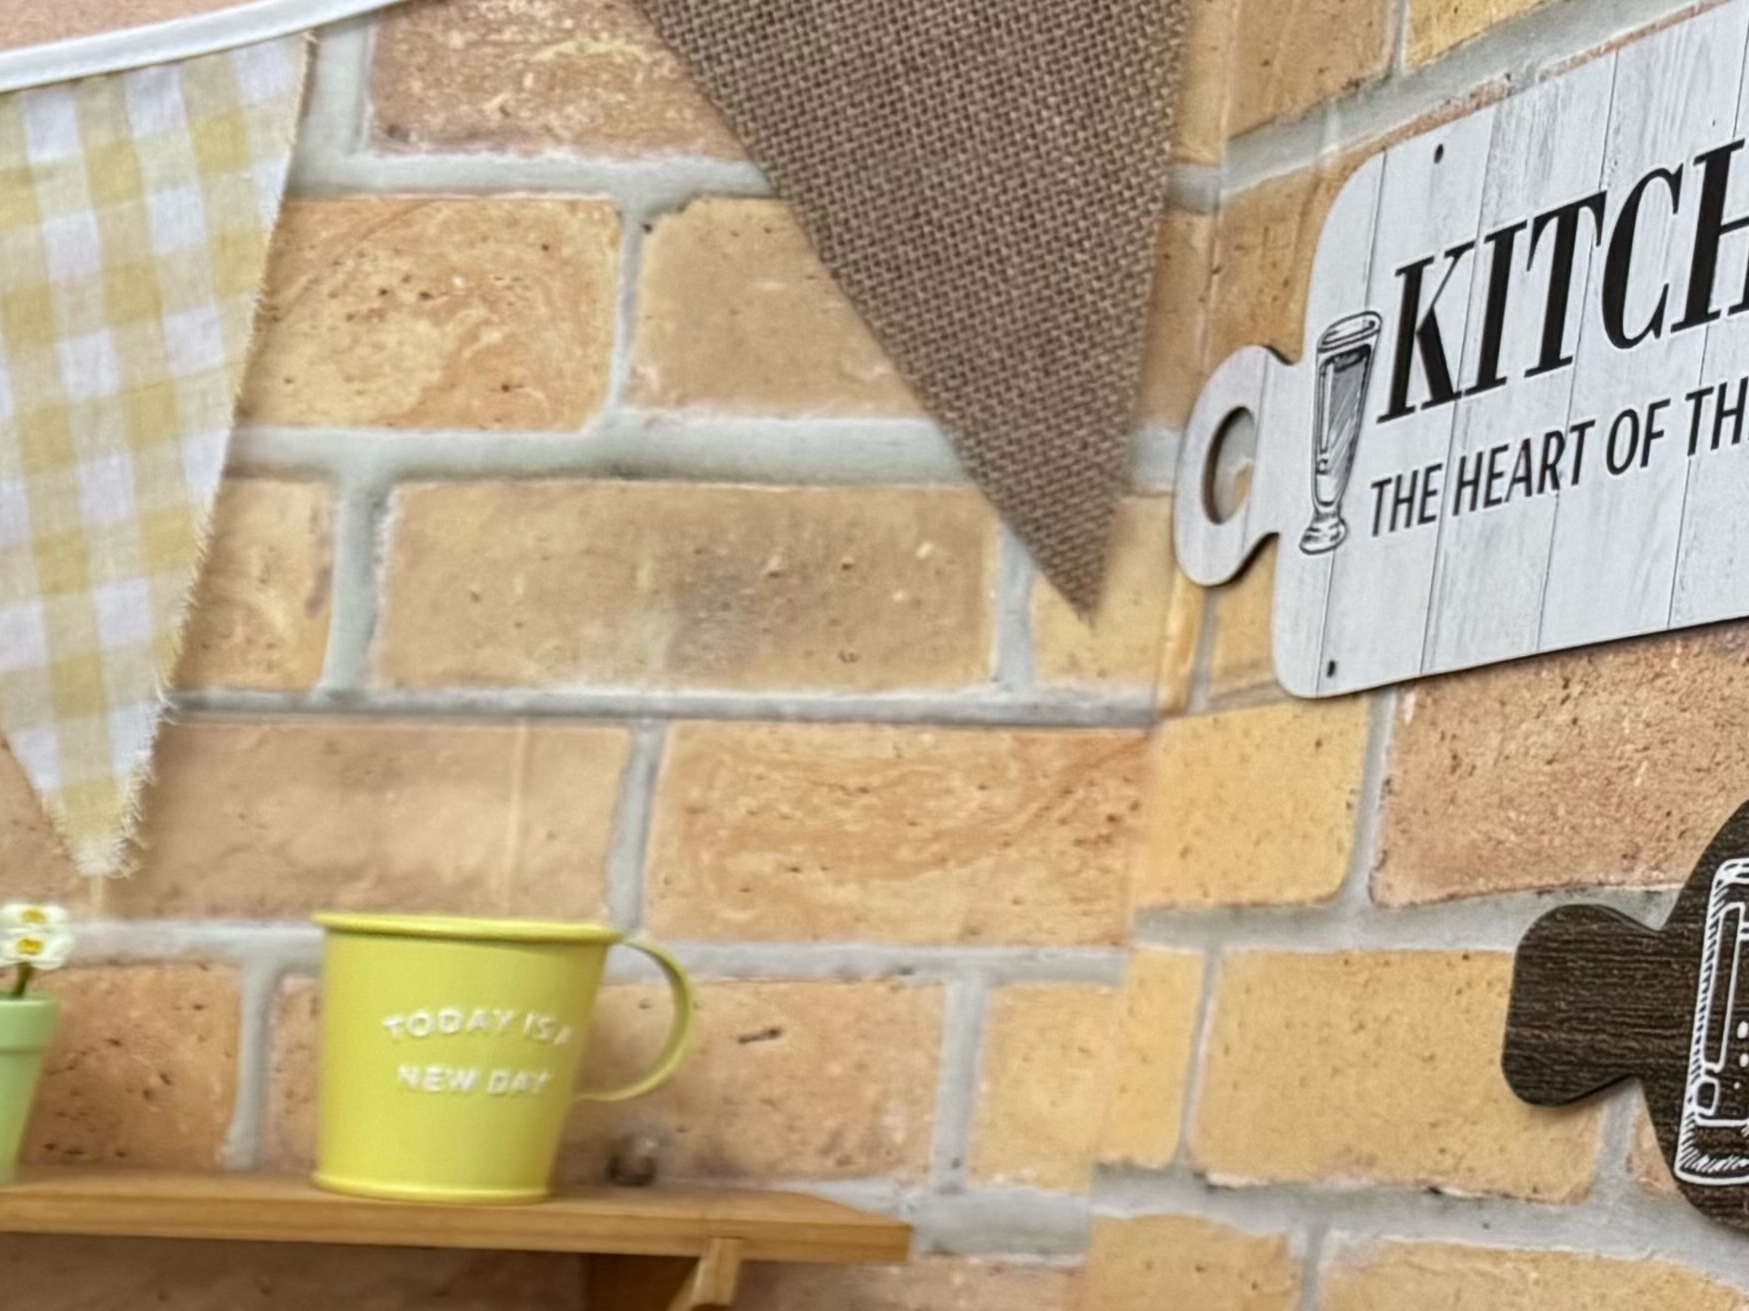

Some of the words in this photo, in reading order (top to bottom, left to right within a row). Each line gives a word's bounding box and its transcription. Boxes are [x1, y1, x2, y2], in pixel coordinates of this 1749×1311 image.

[1370, 462, 1443, 536] THE
[1452, 419, 1596, 517] HEART
[1605, 398, 1671, 477] OF
[1685, 375, 1749, 459] TH
[381, 1007, 517, 1040] TODAY
[522, 1011, 555, 1042] IS
[397, 1063, 480, 1094] NEW
[486, 1068, 552, 1096] DAY
